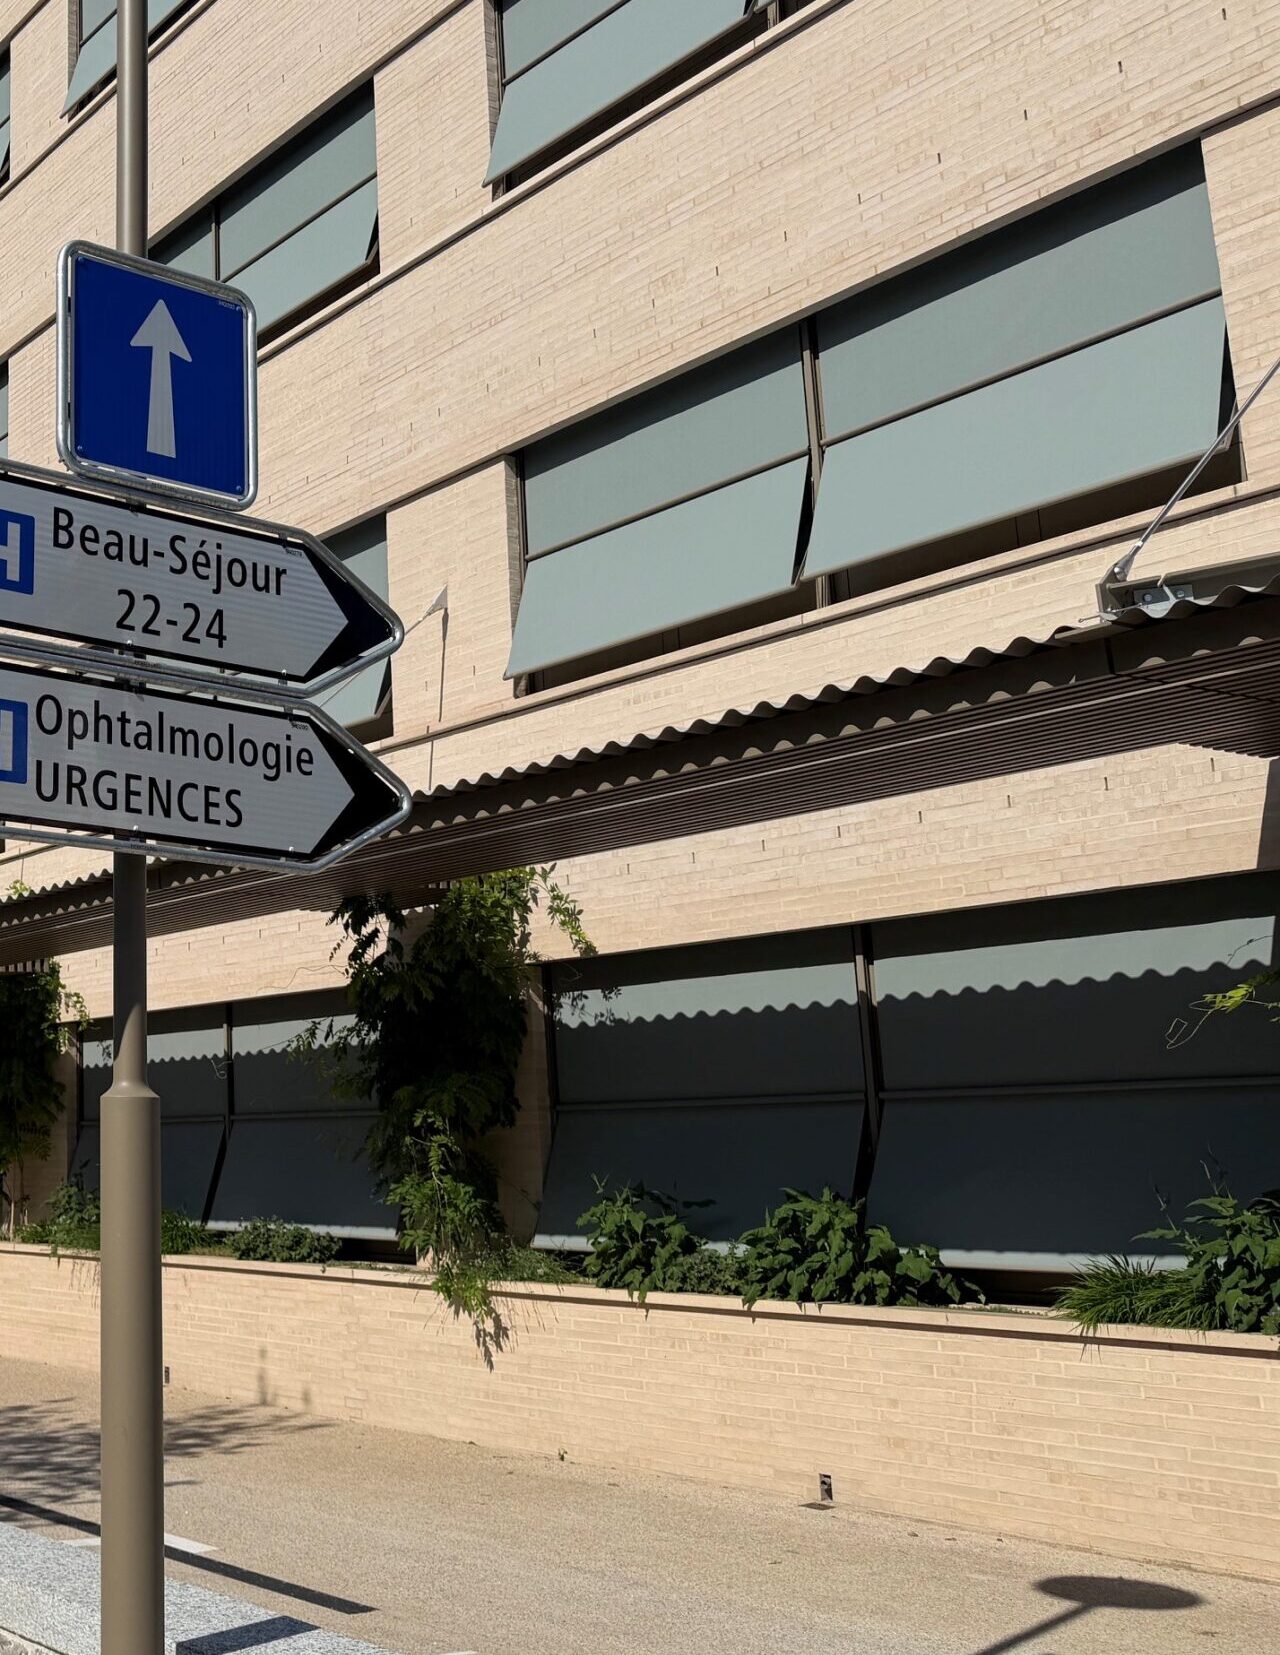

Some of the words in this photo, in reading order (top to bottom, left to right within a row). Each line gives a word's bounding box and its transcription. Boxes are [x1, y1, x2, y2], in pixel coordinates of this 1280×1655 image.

[52, 506, 288, 596] Beau-Séjour
[115, 588, 228, 649] 22-24
[35, 693, 315, 782] Ophtalmologie
[35, 759, 244, 828] URGENCES
